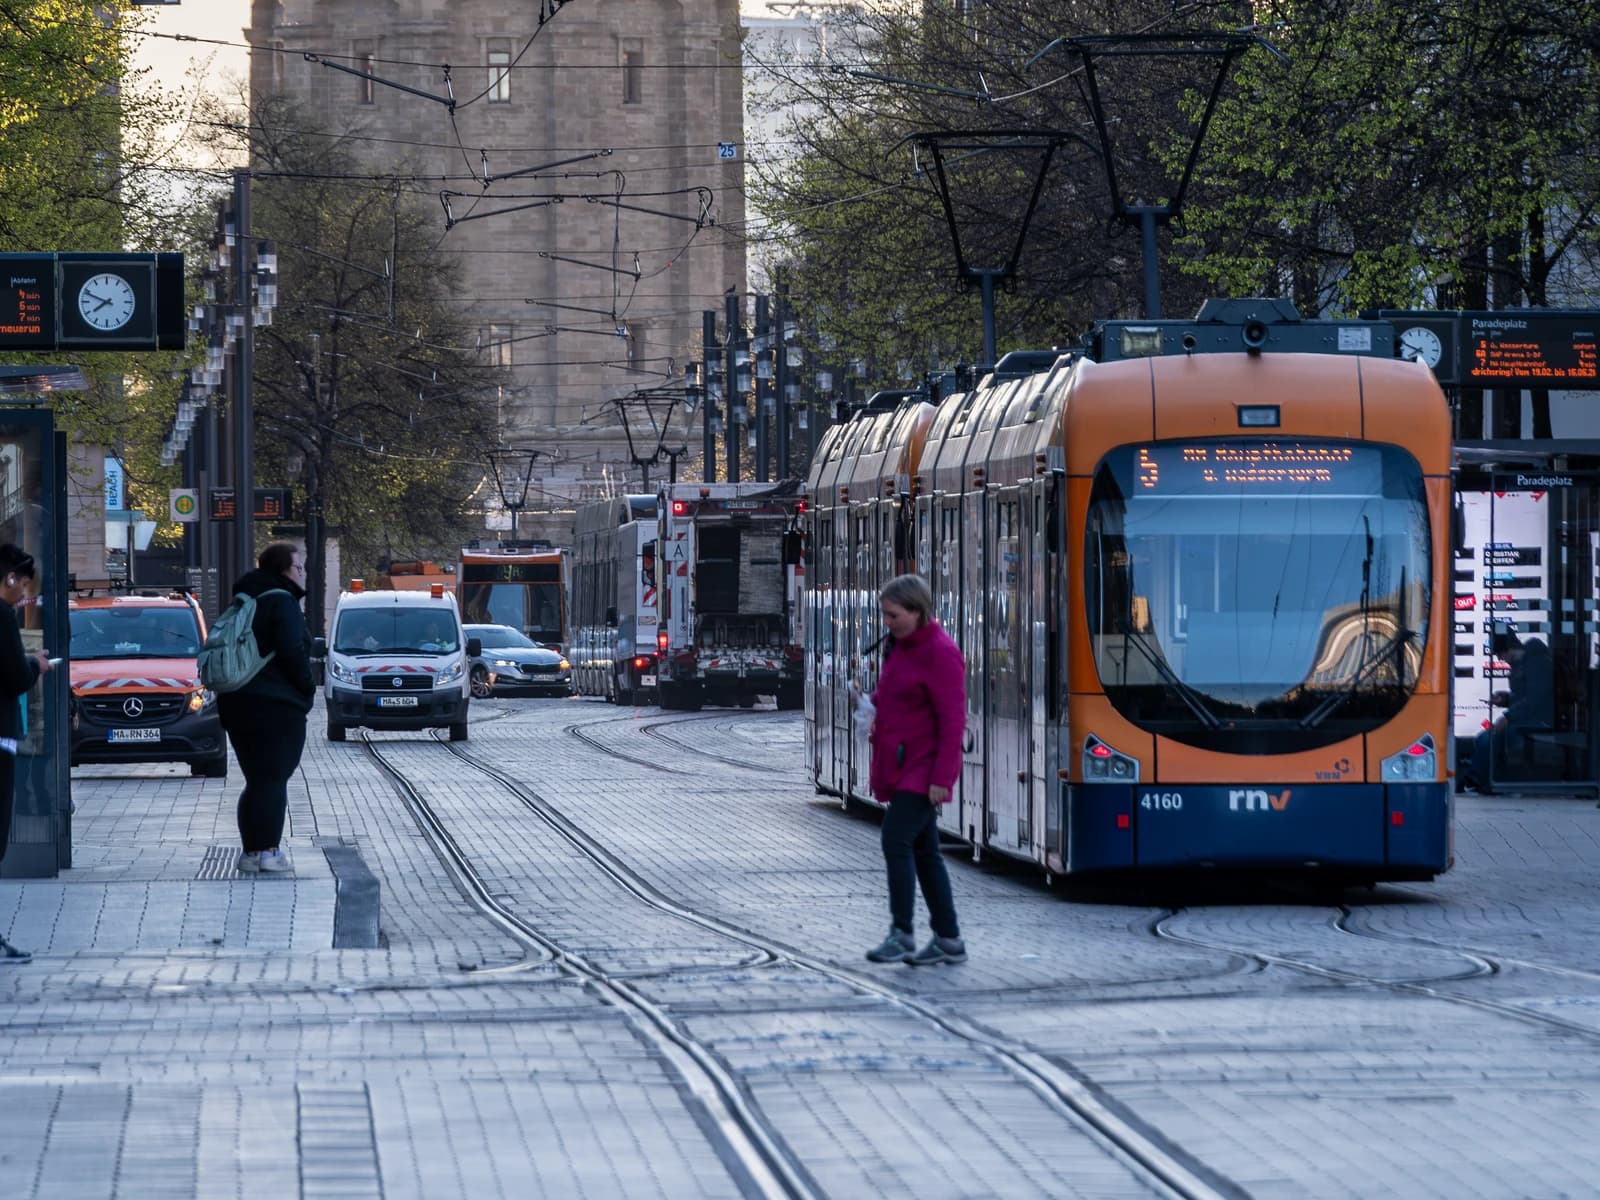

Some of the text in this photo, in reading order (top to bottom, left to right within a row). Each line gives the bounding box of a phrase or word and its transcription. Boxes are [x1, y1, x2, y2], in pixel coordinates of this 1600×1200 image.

[720, 145, 734, 157] 25
[1472, 319, 1527, 331] Paradeplatz
[1517, 474, 1573, 486] Paradeplatz
[109, 470, 118, 506] BEACH
[673, 544, 684, 557] A
[143, 729, 159, 738] 364
[1141, 793, 1184, 810] 4160
[1229, 789, 1292, 811] rnv
